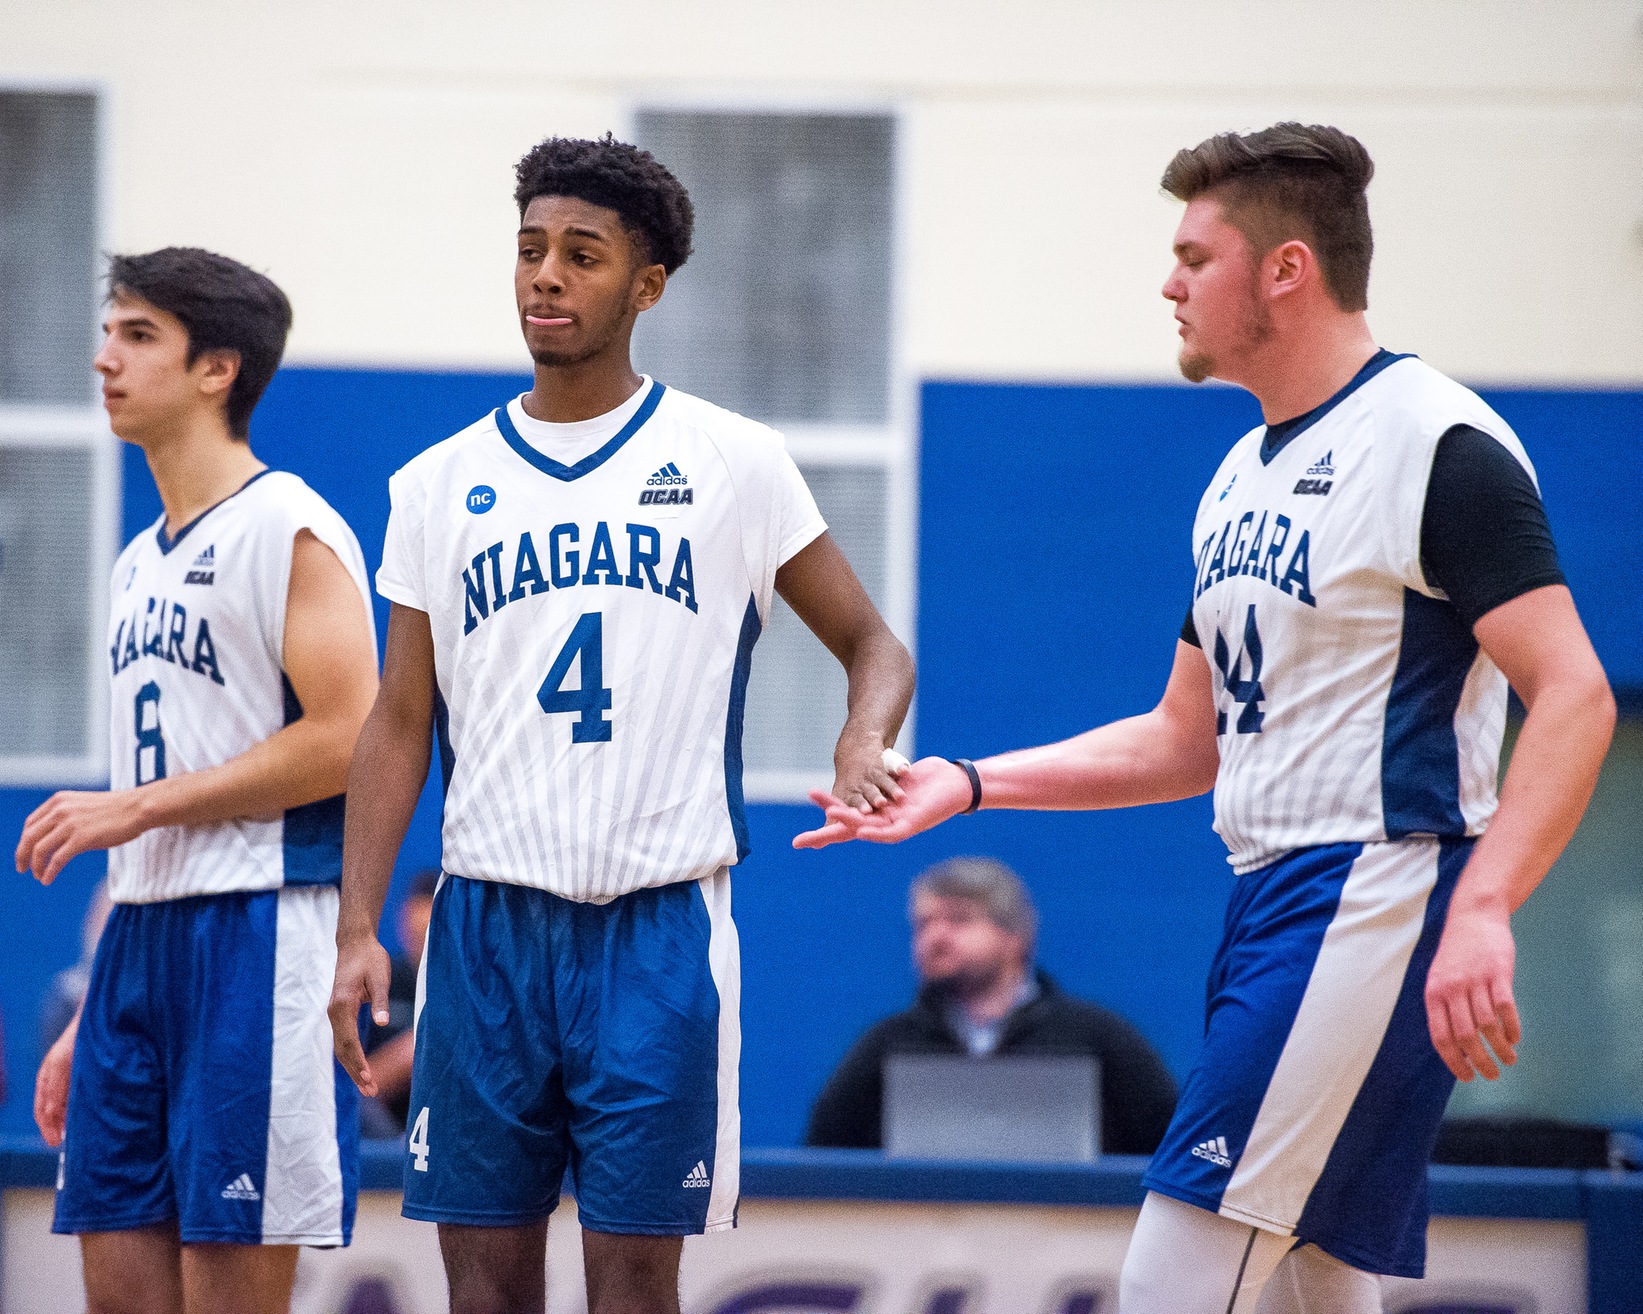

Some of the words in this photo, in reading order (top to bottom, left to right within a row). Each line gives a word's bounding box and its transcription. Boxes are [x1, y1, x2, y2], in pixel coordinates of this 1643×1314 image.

[470, 492, 491, 506] nc
[638, 488, 694, 506] OCAA
[646, 476, 688, 486] adidas
[461, 521, 699, 637] NIAGARA
[1195, 509, 1317, 608] IAGARA
[536, 611, 613, 744] 4
[409, 1106, 430, 1172] 4
[682, 1177, 710, 1188] adidas
